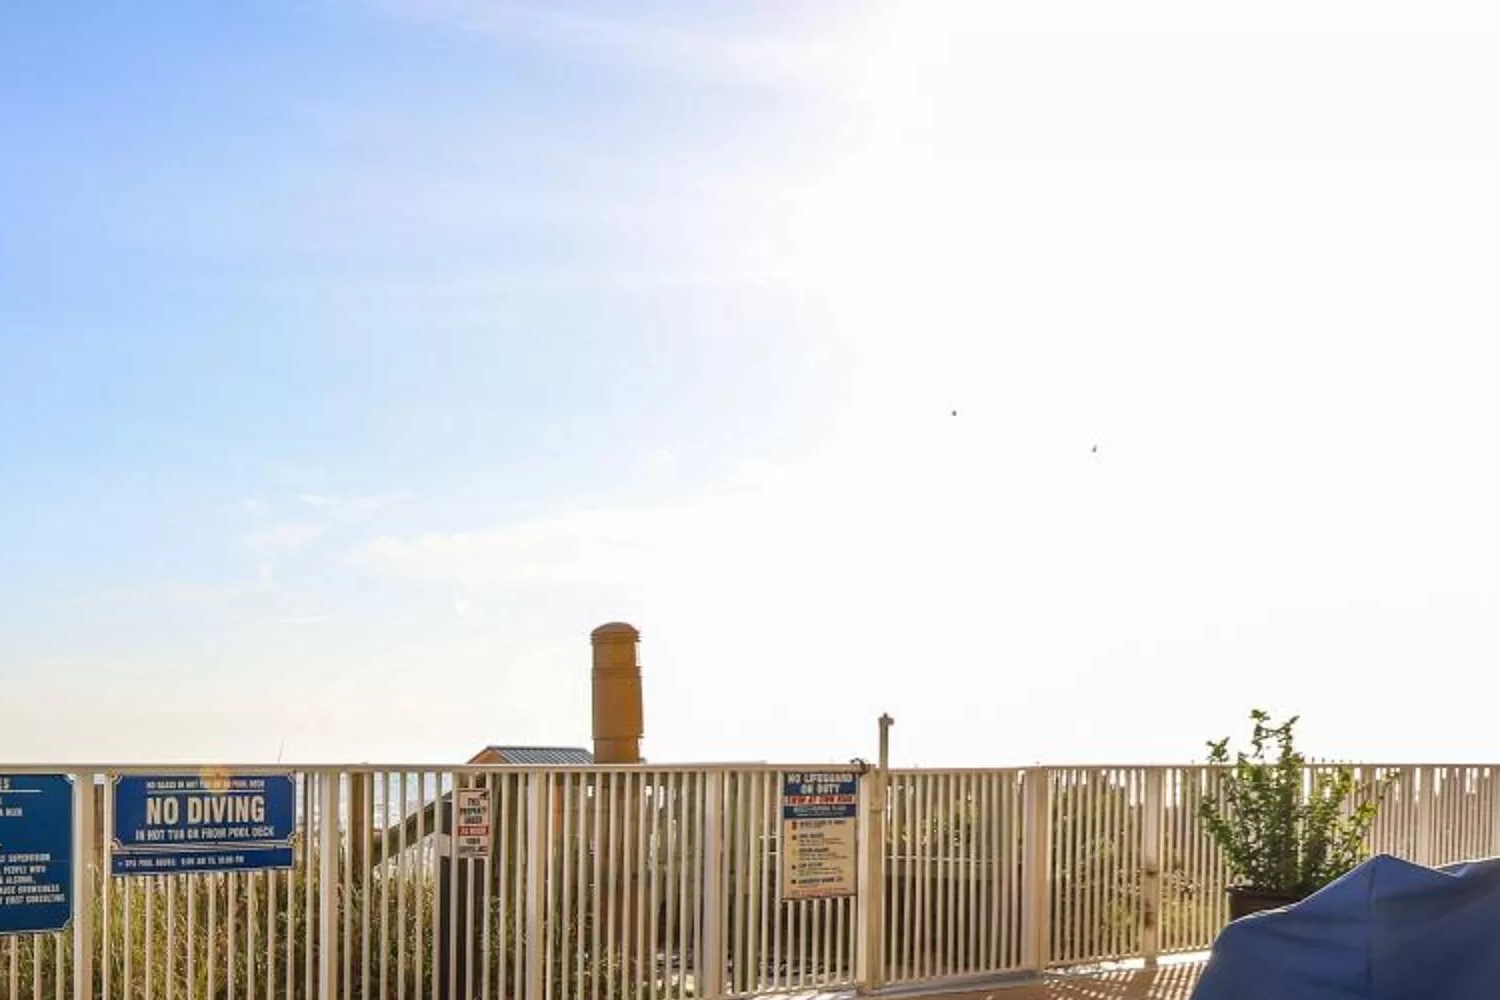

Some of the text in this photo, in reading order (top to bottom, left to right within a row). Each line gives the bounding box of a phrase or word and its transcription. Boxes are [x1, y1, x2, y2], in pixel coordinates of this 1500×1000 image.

[788, 772, 853, 784] NO LIFEGUARD
[800, 783, 841, 794] ON DUTY
[147, 795, 265, 824] NO DIVING
[135, 826, 275, 840] IN HOT TUB OR FROM POOL DECK
[4, 866, 28, 874] PEOPLE
